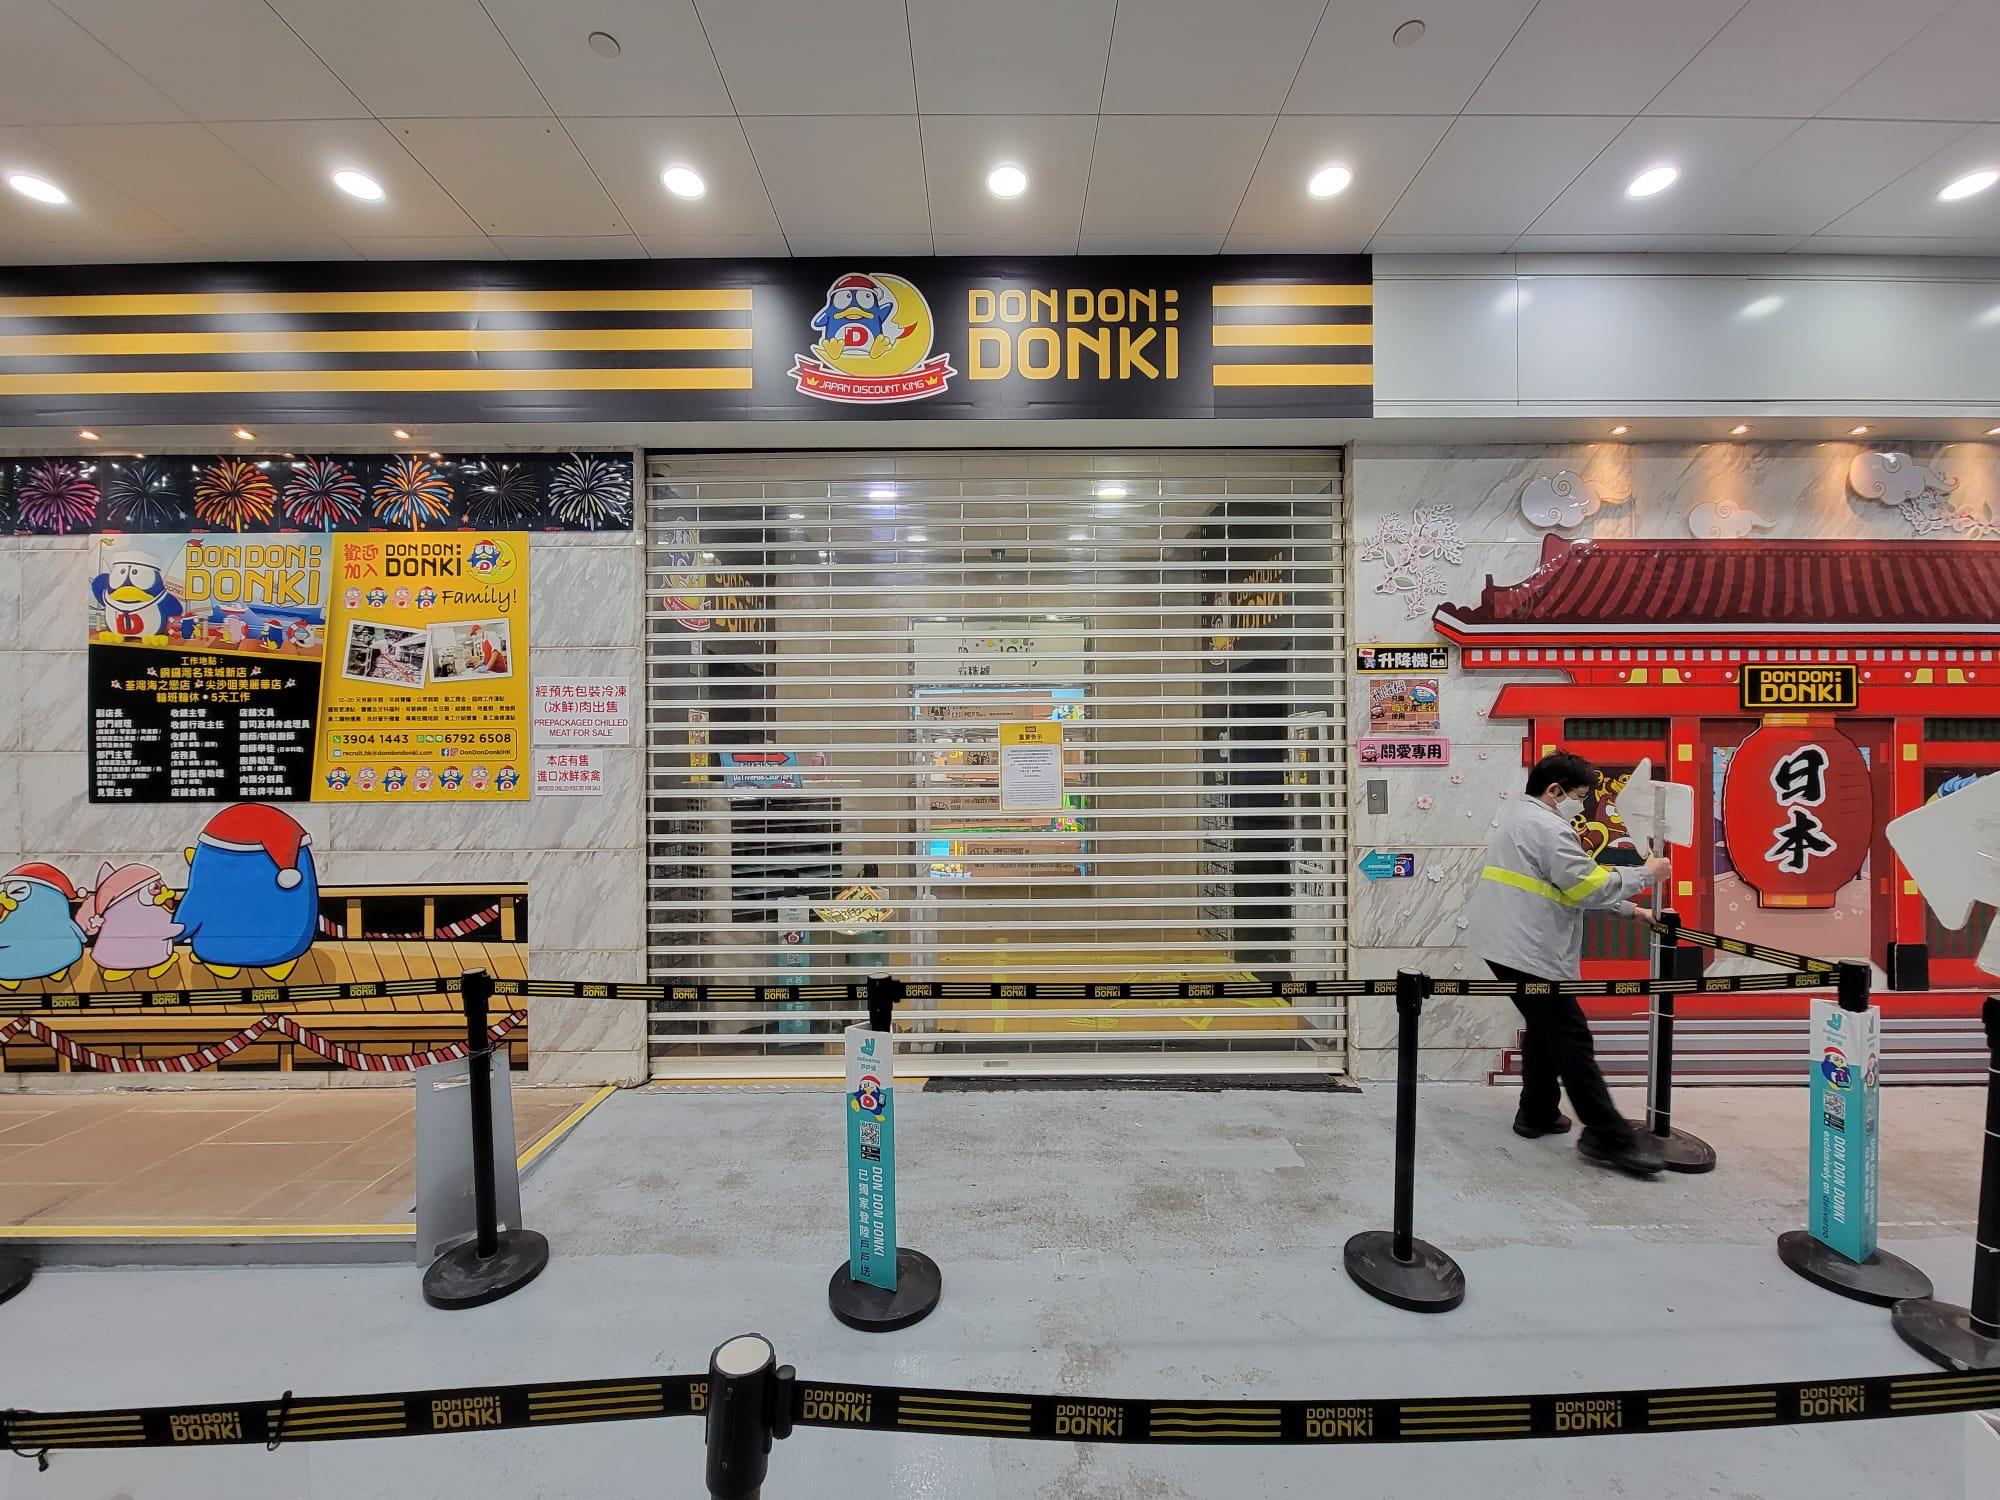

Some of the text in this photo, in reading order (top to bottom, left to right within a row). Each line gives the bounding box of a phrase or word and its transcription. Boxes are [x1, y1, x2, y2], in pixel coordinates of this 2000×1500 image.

[968, 327, 1178, 380] DONKI
[819, 380, 925, 395] JAPAN DISCOUNT KING
[344, 544, 378, 562] 歡迎
[344, 563, 378, 580] 加入
[386, 558, 461, 577] DONKI
[186, 569, 320, 605] DONKI
[442, 585, 517, 612] Family!
[1378, 652, 1428, 668] 升降機
[211, 692, 250, 703] 5天工作
[536, 685, 628, 698] 經預先包裝冷凍
[1760, 684, 1842, 702] DONKI
[544, 700, 618, 713] (冰鮮)肉出售
[343, 734, 408, 744] 3904 1443
[444, 734, 511, 743] 6792 6508
[546, 754, 589, 766] 本店有售
[1380, 744, 1442, 760] 關愛專用
[537, 770, 600, 782] 進口冰鮮家禽
[1770, 746, 1835, 872] 日本
[1834, 1136, 1846, 1162] DON
[1834, 1162, 1846, 1187] DON
[1821, 1131, 1832, 1238] exclusively on deliveroo
[872, 1166, 884, 1256] DON DON DONKI
[1833, 1188, 1846, 1224] DONKI
[803, 1402, 871, 1422] DONKI
[1800, 1397, 1865, 1416] DONKI
[432, 1407, 502, 1428] DONKI
[1056, 1416, 1122, 1436] DONKI
[1556, 1412, 1622, 1430] DONKI
[172, 1422, 242, 1441] DONKI
[1306, 1418, 1372, 1437] DONKI
